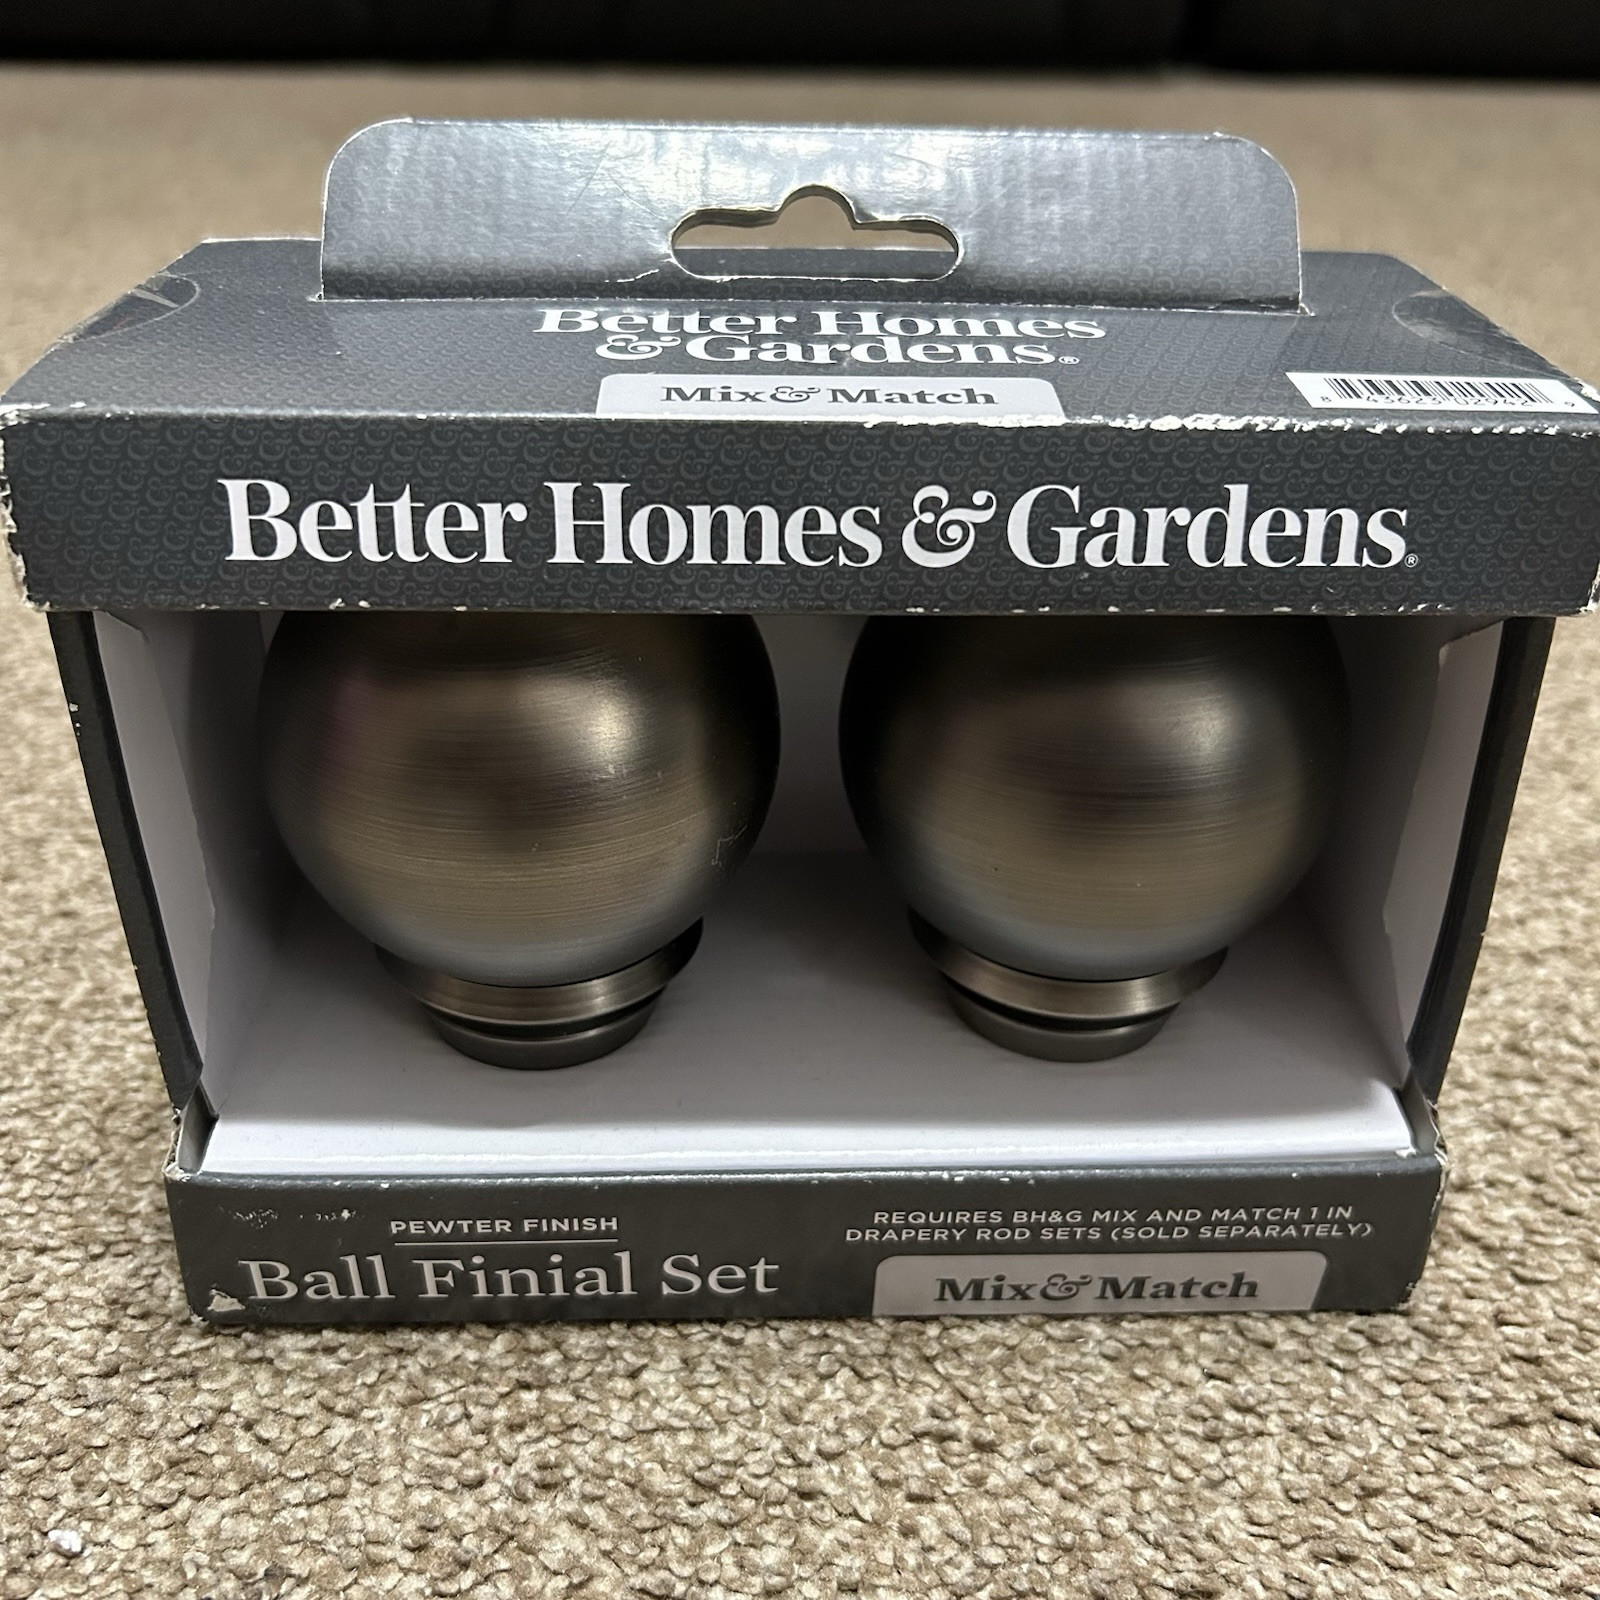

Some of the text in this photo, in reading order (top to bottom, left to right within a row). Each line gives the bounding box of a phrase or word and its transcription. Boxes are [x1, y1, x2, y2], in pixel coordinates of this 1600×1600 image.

[532, 309, 1107, 341] Better Homes
[595, 333, 682, 361] &
[217, 478, 528, 564] Better
[543, 482, 882, 569] Homes
[901, 485, 997, 569] &
[391, 1216, 619, 1234] PEWTER FINISH
[873, 1205, 1354, 1225] REQUIRES BH&G MIX AND MATCH 1 IN
[845, 1222, 1374, 1242] DRAPERY ROD SETS (SOLD SEPARATELY)
[237, 1250, 781, 1300] Ball Finial Set
